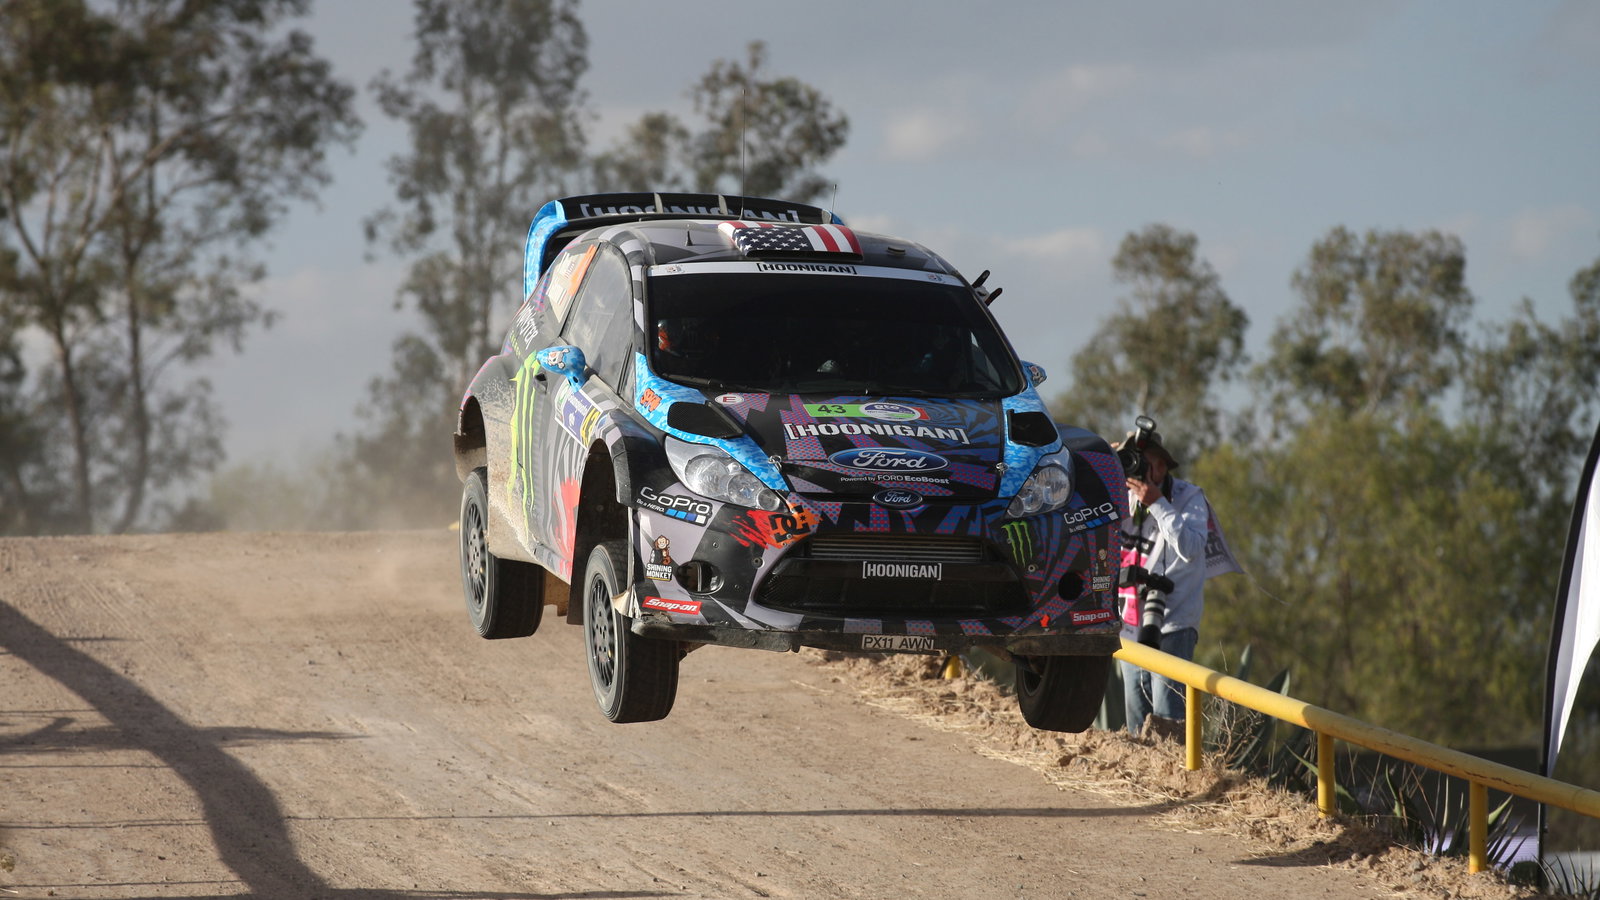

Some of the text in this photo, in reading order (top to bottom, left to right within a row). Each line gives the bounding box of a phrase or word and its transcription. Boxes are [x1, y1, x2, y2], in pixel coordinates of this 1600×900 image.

[757, 263, 857, 275] [HOONIGAN]
[817, 404, 846, 413] 43
[784, 422, 971, 444] [HOONIGAN]
[852, 451, 927, 469] Ford
[904, 475, 950, 484] EcoBoost
[640, 486, 710, 514] GoPro
[884, 491, 911, 503] Ford
[1064, 502, 1113, 524] GoPro
[647, 563, 672, 573] SHINING
[862, 561, 942, 581] [HOONIGAN]
[646, 570, 672, 580] MONKEY
[645, 598, 698, 612] Snap-on
[1073, 611, 1110, 622] Snap-on
[863, 637, 933, 650] PX11 AWN
